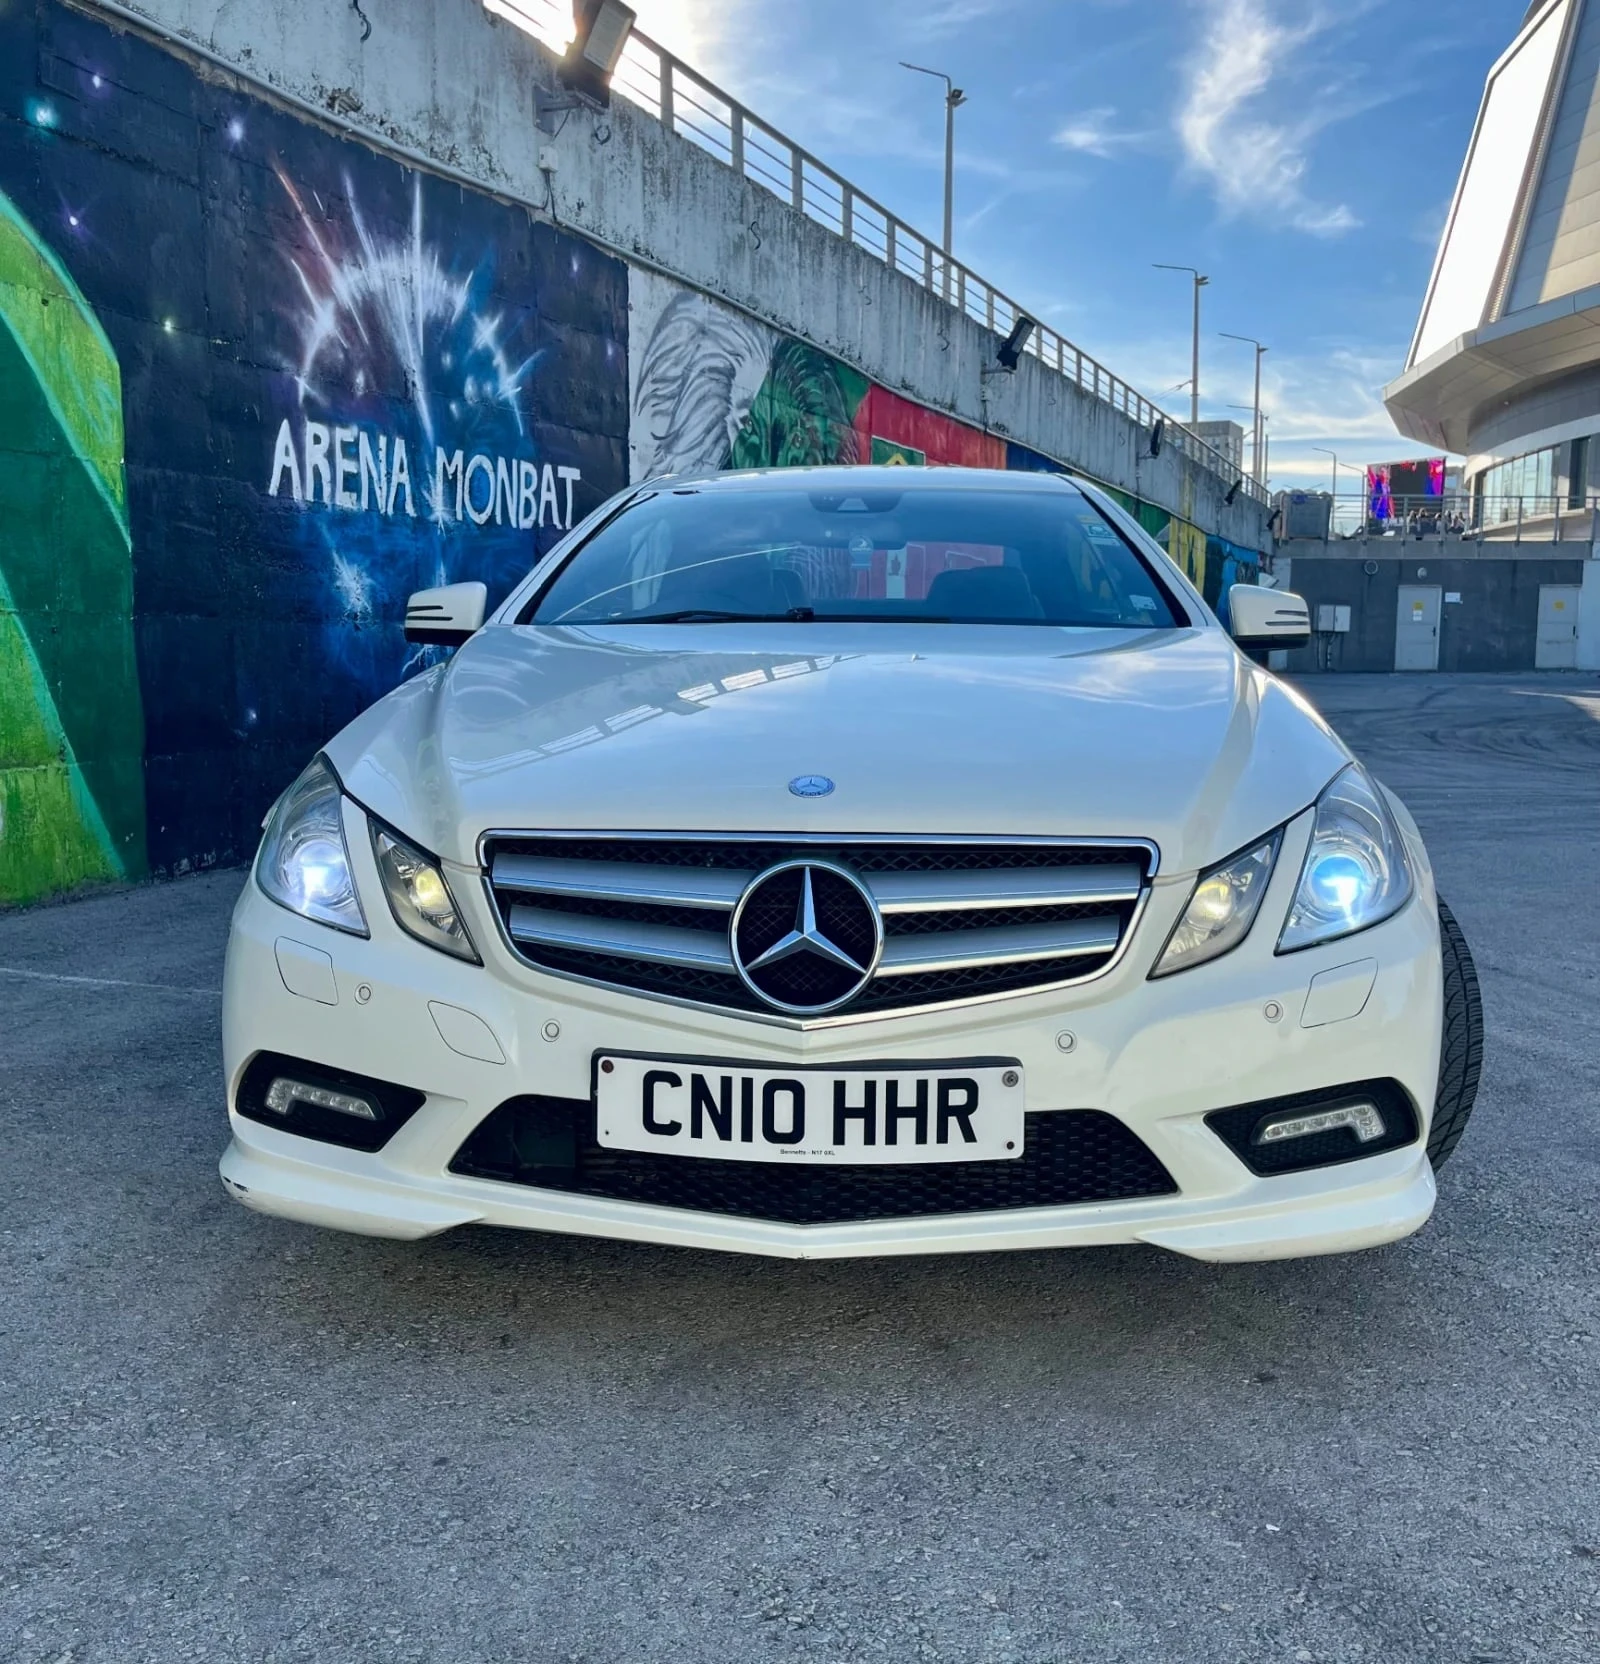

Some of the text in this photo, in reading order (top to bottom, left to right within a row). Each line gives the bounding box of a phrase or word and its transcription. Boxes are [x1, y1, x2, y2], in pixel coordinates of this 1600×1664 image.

[268, 418, 581, 529] ARENA MONBAT
[642, 1070, 980, 1146] CN10 HHR
